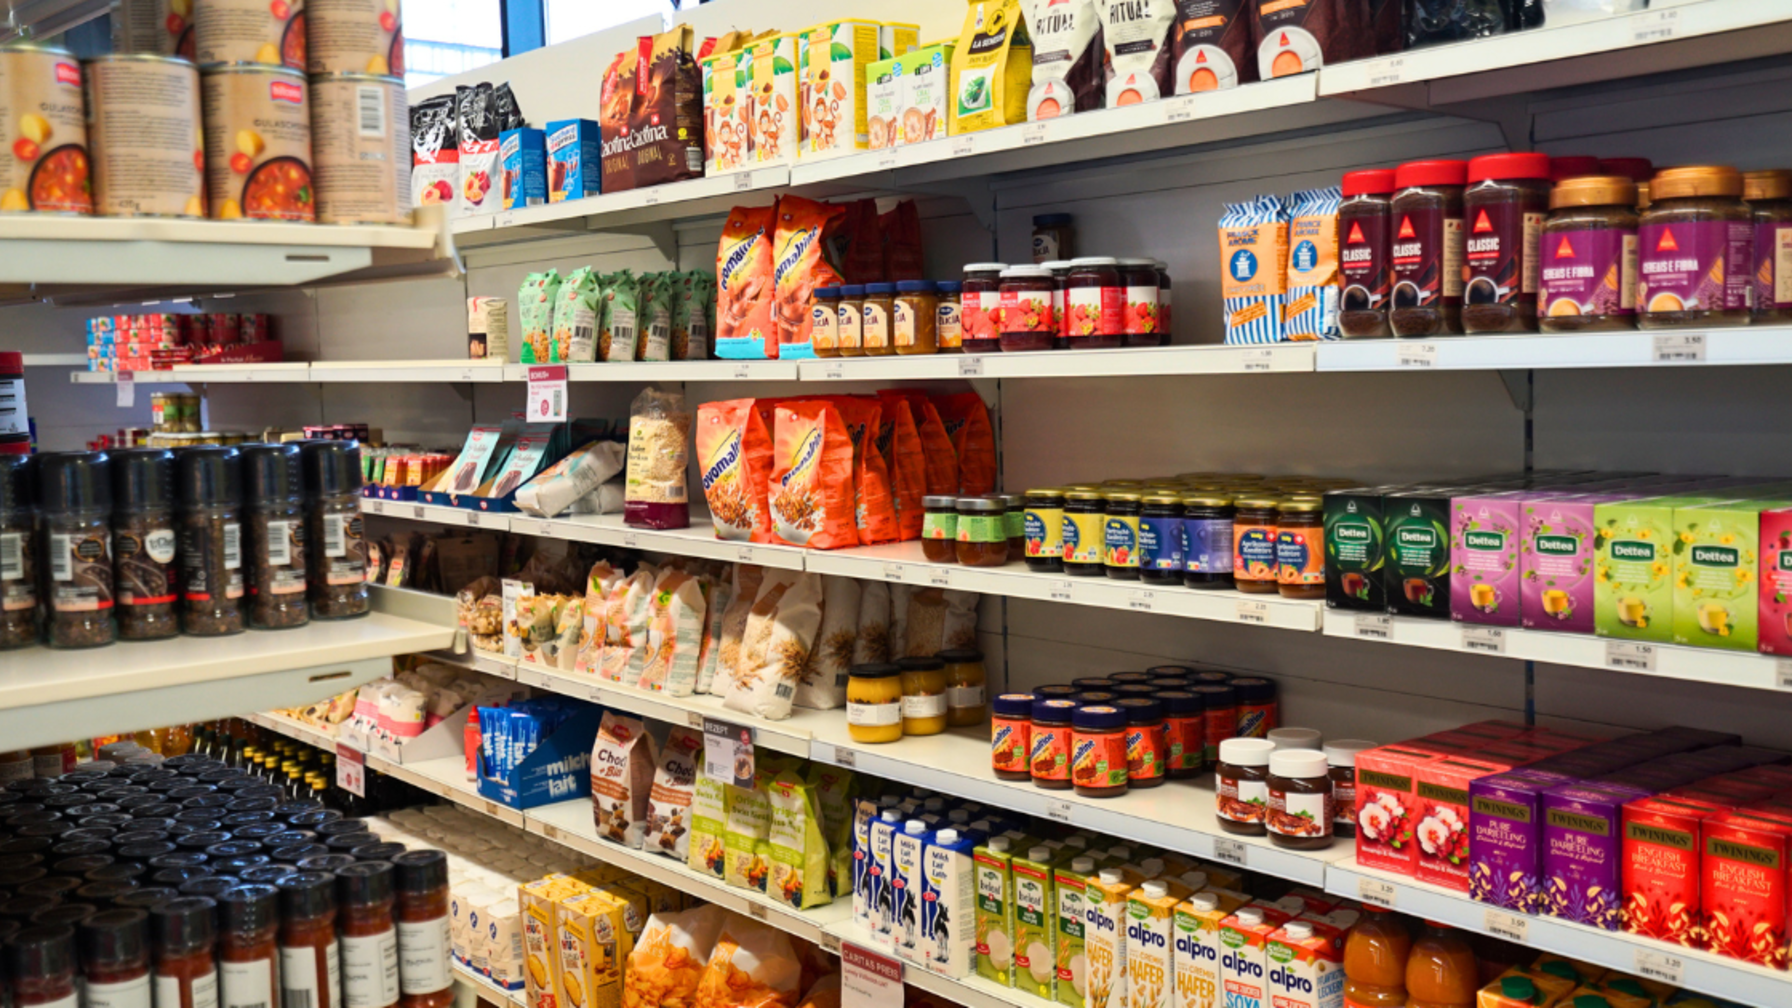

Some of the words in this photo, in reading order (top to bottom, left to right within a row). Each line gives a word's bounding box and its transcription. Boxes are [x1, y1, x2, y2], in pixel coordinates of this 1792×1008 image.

[1109, 0, 1153, 24] RITUAL
[1036, 13, 1075, 35] RITUAL
[629, 124, 669, 150] Caotina
[1342, 248, 1372, 261] CLASSIC
[1393, 243, 1422, 257] CLASSIC
[1467, 237, 1500, 253] CLASSIC
[1566, 267, 1571, 278] E
[1668, 260, 1674, 271] E
[704, 722, 729, 735] REZEPT
[547, 751, 591, 777] milch
[548, 773, 577, 798] lait
[1361, 771, 1410, 790] TWININGS
[1421, 782, 1469, 804] TWININGS
[1475, 799, 1526, 819] TWININGS
[1489, 820, 1512, 832] PURE
[1551, 811, 1606, 832] TWININGS
[900, 839, 916, 851] Milch
[1475, 825, 1527, 844] DARJEELING
[1564, 833, 1588, 846] PURE
[1631, 825, 1690, 847] TWININGS
[900, 848, 911, 858] Lait
[932, 850, 950, 862] Milch
[1550, 838, 1605, 859] DARJEELING
[1637, 845, 1681, 863] ENGLISH
[1711, 841, 1776, 865] TWININGS
[932, 860, 945, 870] Lait
[1631, 852, 1687, 873] BREAKFAST
[1719, 862, 1765, 881] ENGLISH
[932, 868, 948, 880] Latte
[1712, 870, 1772, 892] BREAKFAST
[1086, 907, 1115, 932] alpro
[1128, 922, 1165, 948] alpro
[1176, 935, 1217, 962] alpro
[843, 949, 875, 970] CARITAS
[1222, 950, 1263, 978] alpro
[1129, 957, 1165, 986] HAFER
[1269, 965, 1313, 995] alpro
[1177, 970, 1215, 1002] HAFER
[1226, 991, 1261, 1008] SOYA
